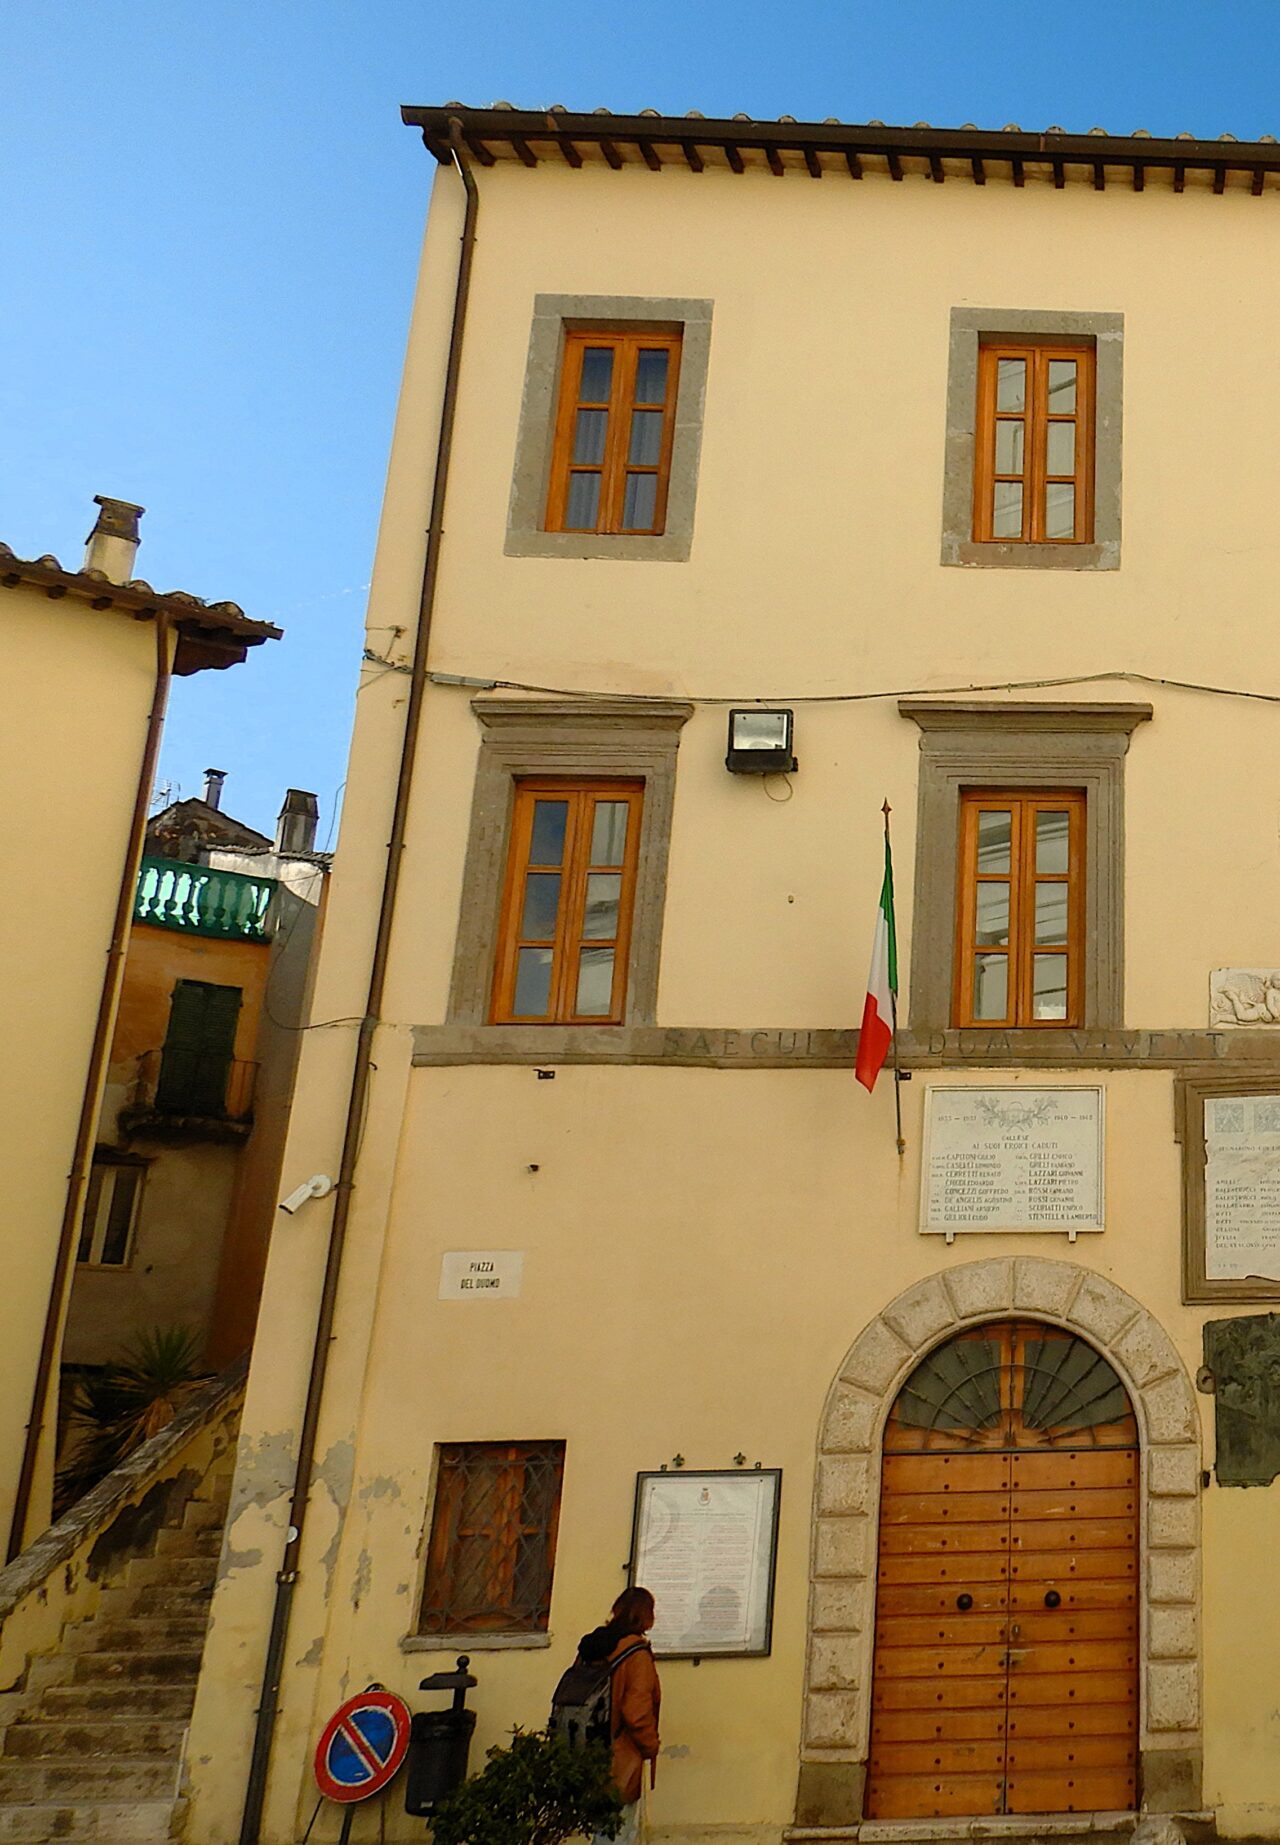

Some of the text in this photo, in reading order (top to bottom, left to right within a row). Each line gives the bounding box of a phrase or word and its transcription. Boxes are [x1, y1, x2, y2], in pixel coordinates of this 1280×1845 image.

[469, 1262, 494, 1272] PIAZZA
[461, 1278, 500, 1289] DEL DUOMO
